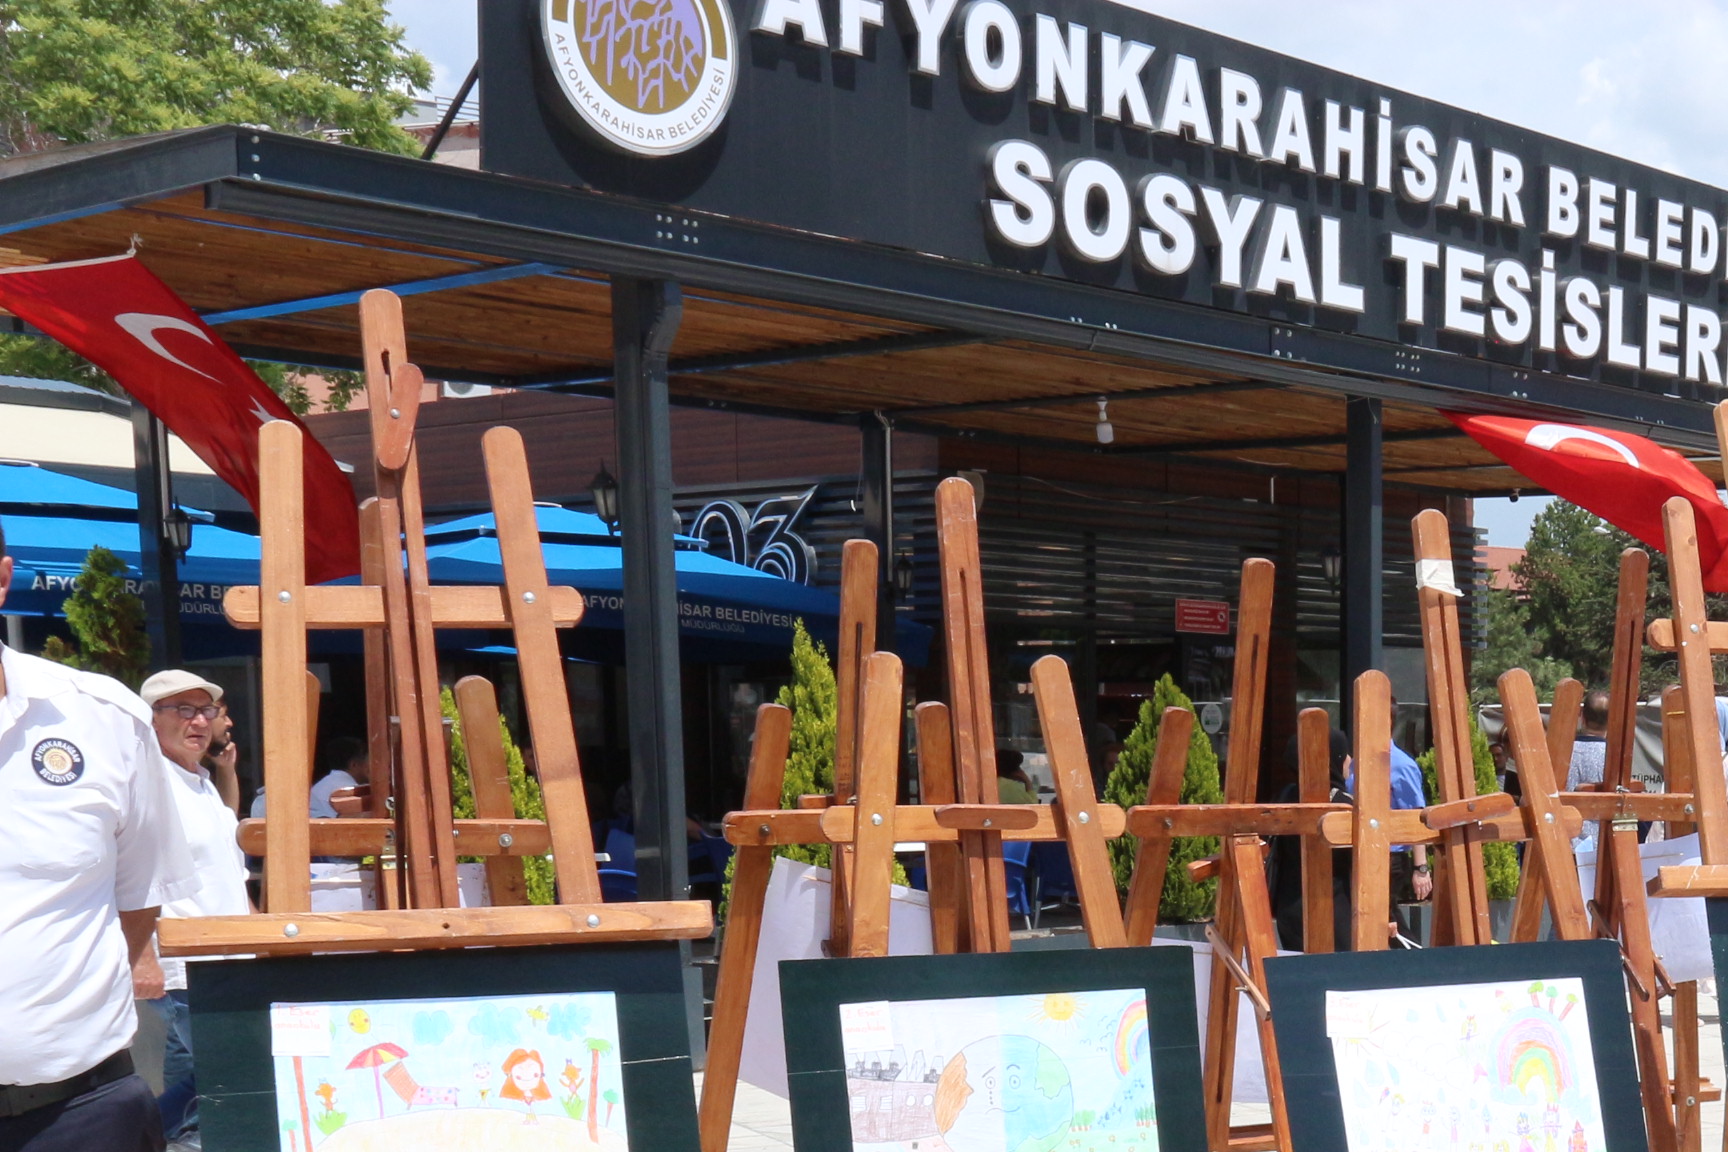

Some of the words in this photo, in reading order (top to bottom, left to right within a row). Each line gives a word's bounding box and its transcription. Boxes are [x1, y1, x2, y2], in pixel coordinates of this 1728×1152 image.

[555, 33, 665, 140] AFYONKARAHİSAR
[669, 68, 725, 139] BELEDİYESİ
[988, 139, 1365, 314] SOSYAL
[715, 605, 793, 628] BELEDİYESİ
